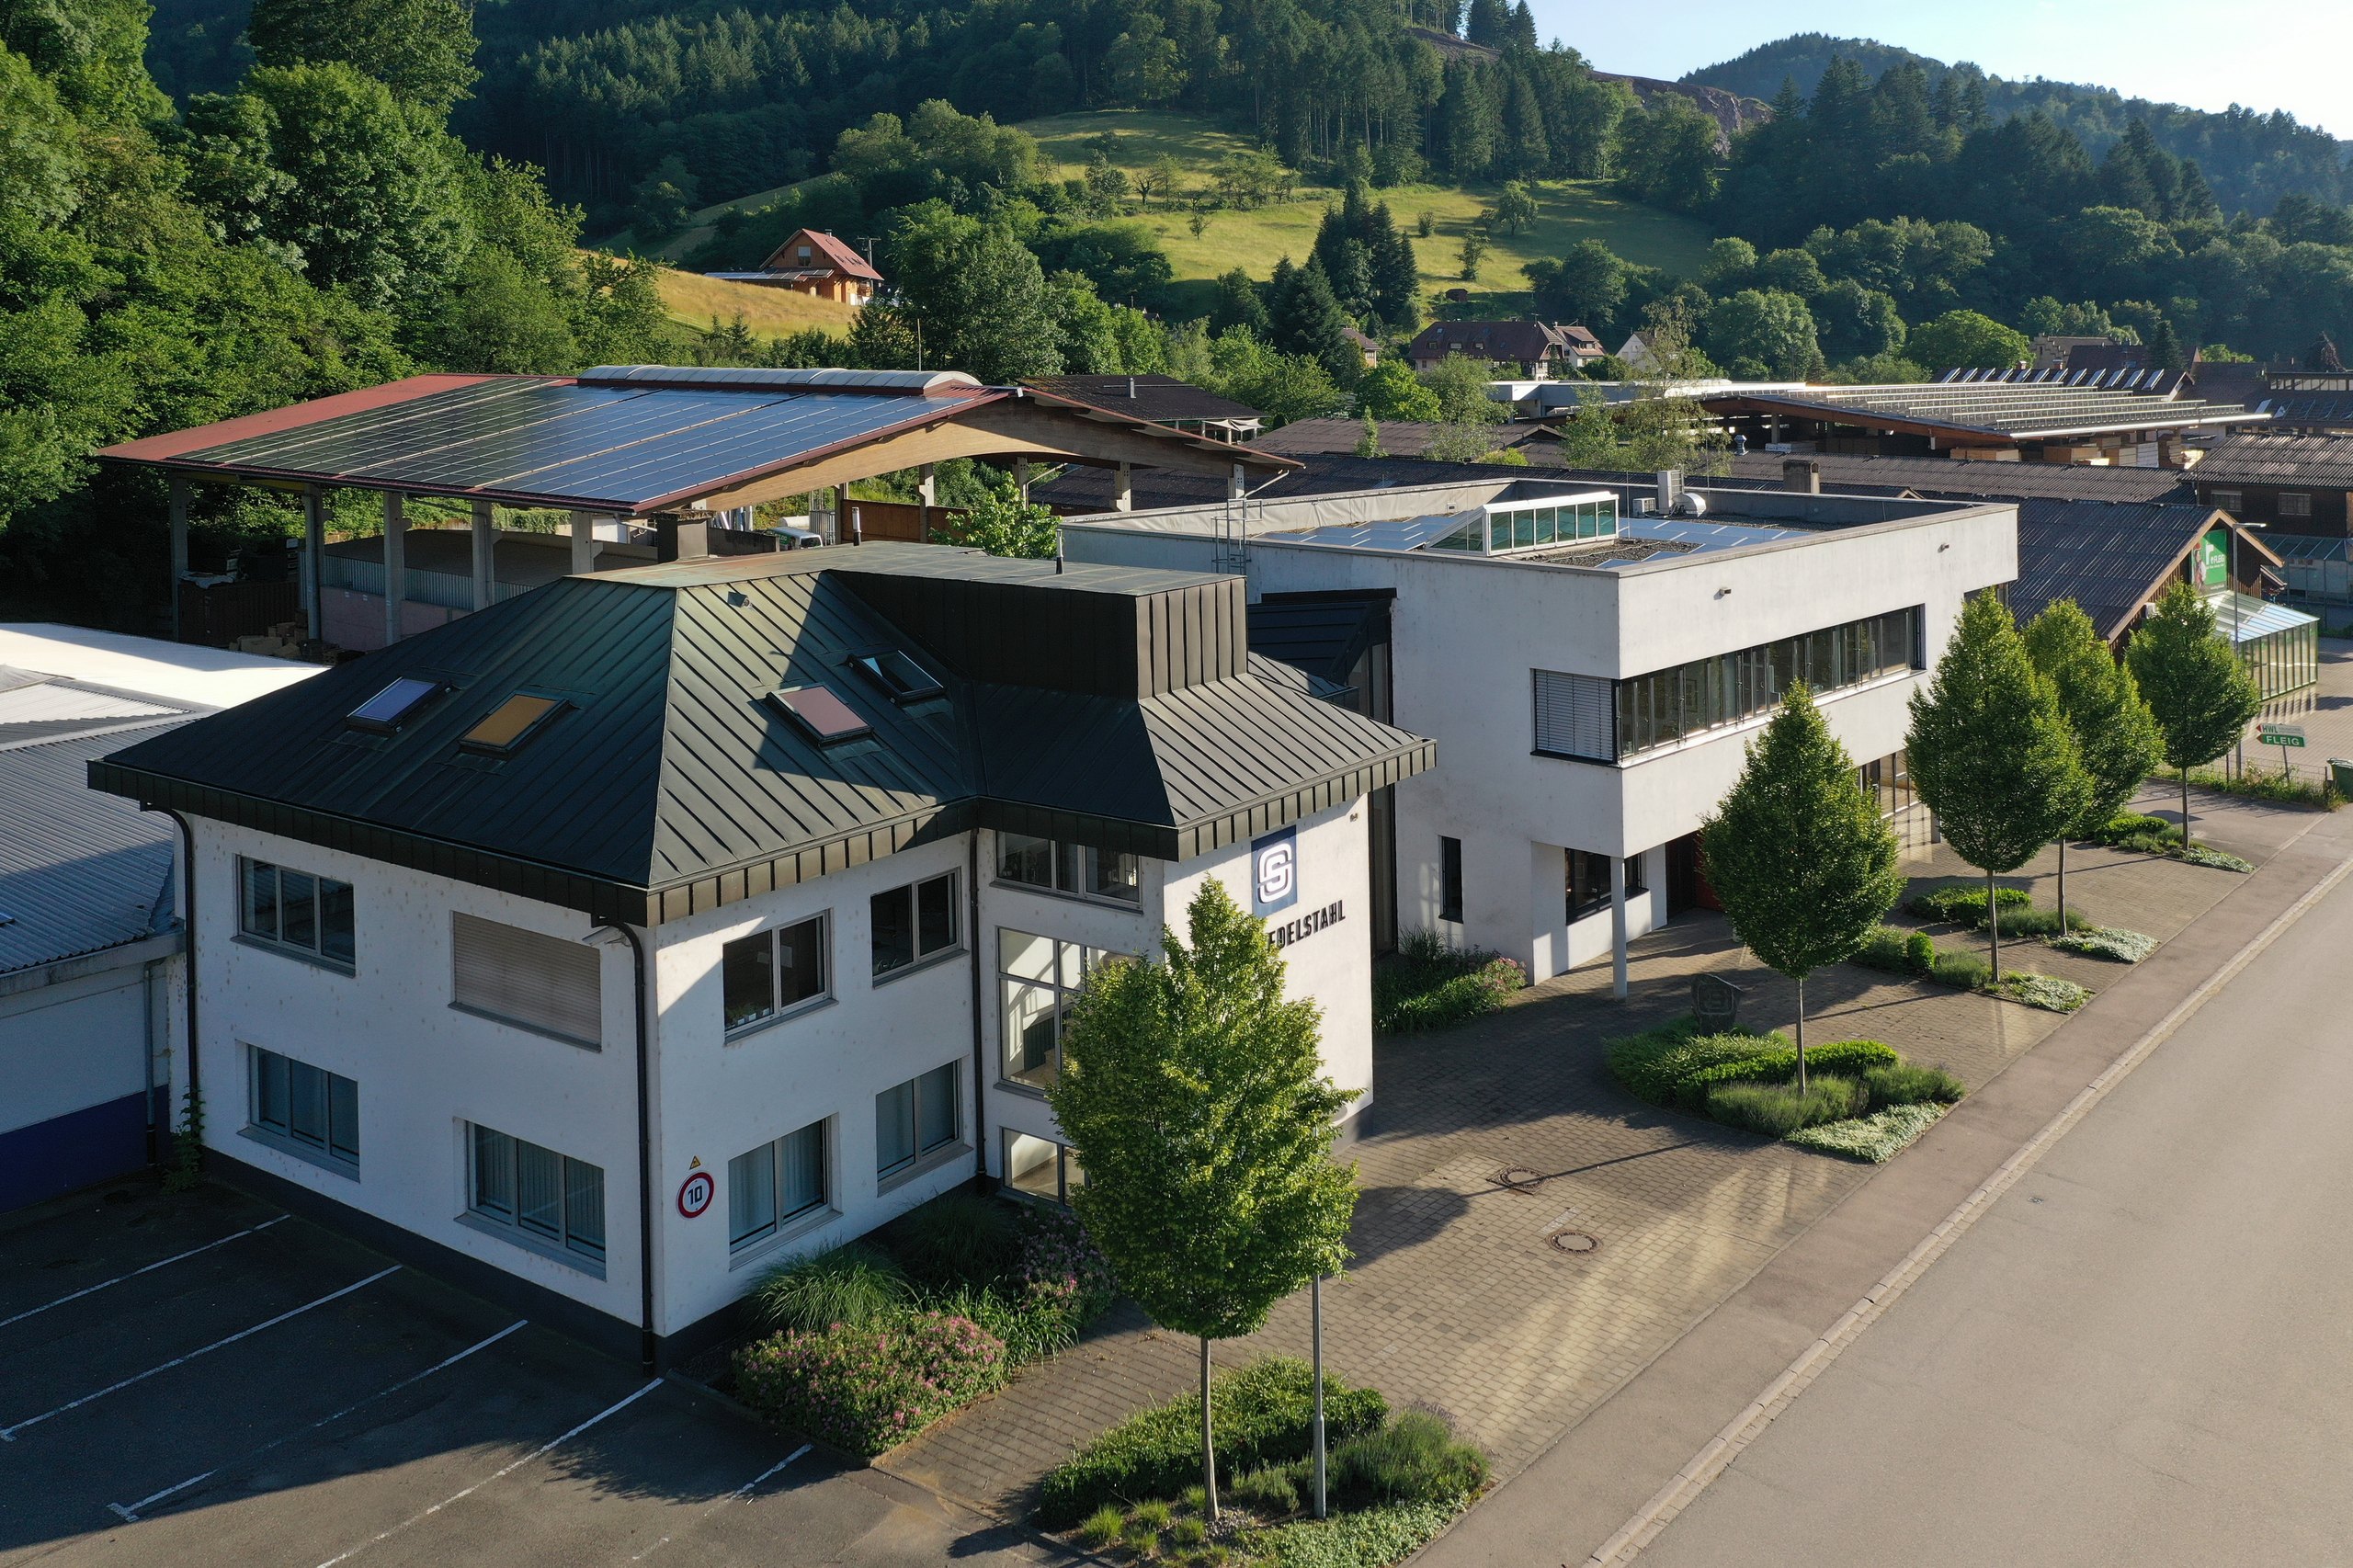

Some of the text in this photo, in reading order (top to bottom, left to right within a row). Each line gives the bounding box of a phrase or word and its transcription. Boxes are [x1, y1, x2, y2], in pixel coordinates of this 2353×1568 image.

[2262, 725, 2278, 733] HWL
[2266, 735, 2300, 746] FLEIG
[1267, 899, 1347, 950] EDELSTAHL
[688, 1185, 703, 1206] 10
